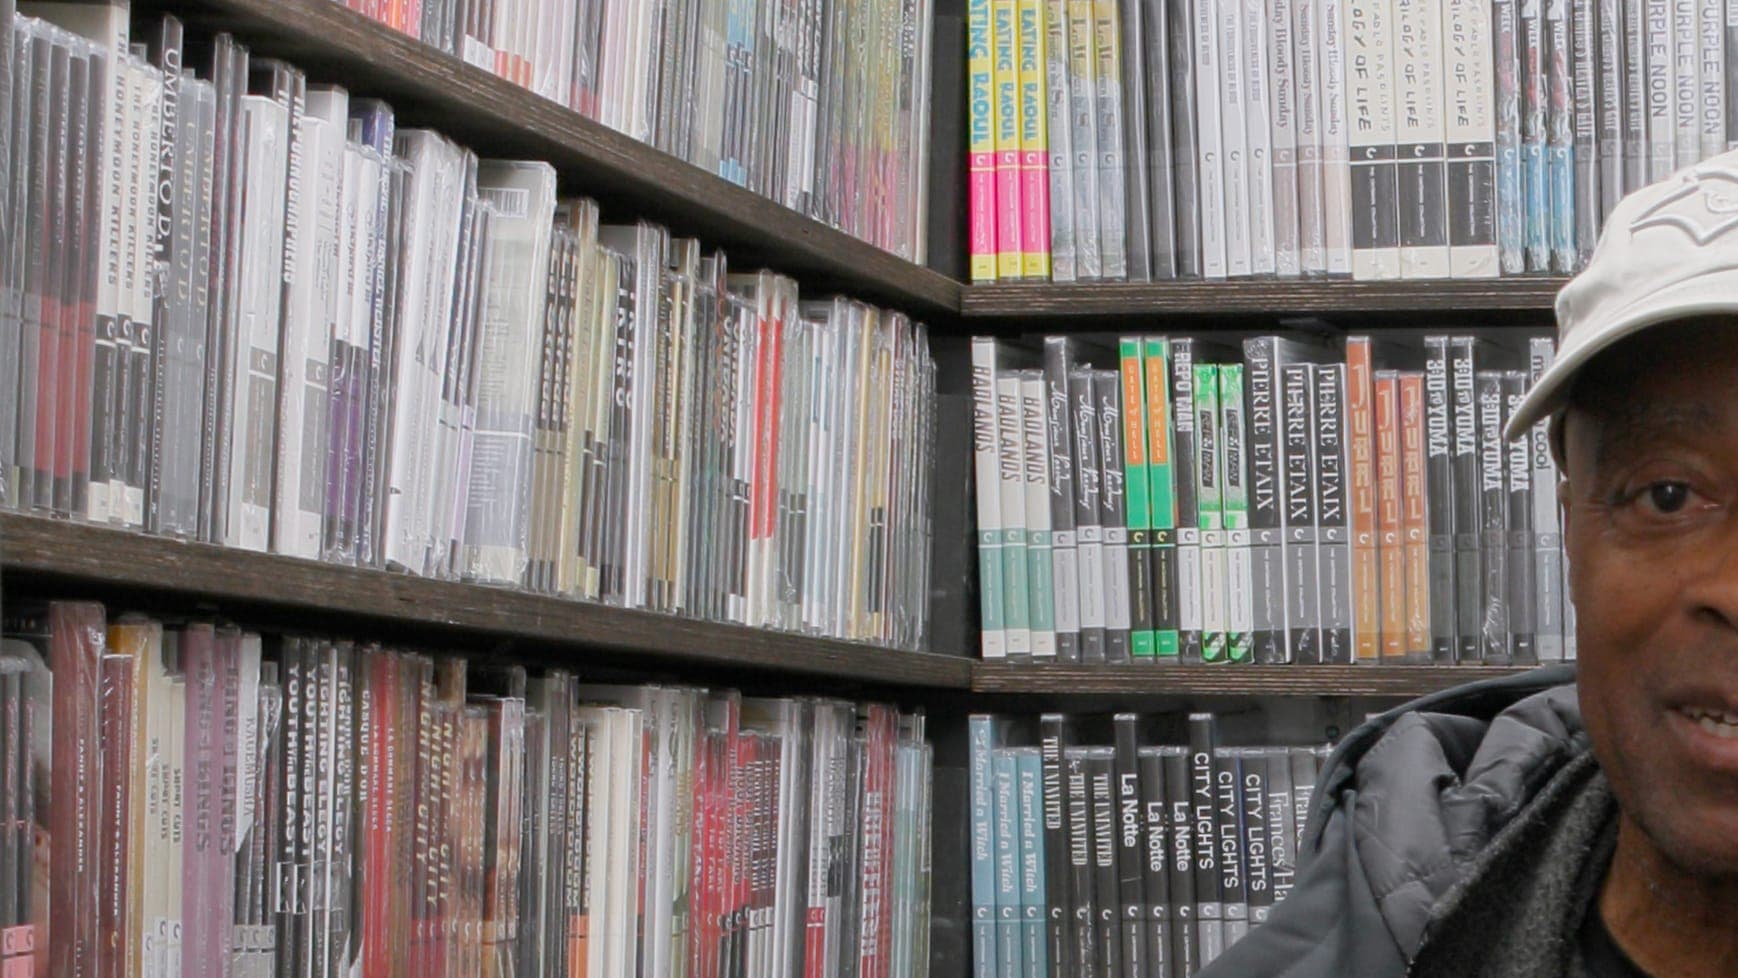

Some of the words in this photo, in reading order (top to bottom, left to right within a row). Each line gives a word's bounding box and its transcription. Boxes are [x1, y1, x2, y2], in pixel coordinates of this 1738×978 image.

[116, 31, 126, 65] THE
[996, 9, 1012, 71] EATING
[1022, 9, 1037, 71] EATING
[1274, 28, 1292, 75] Bloody
[1355, 55, 1368, 79] OF
[1404, 64, 1417, 83] OF
[1455, 63, 1466, 82] OF
[1651, 65, 1667, 118] NOON
[1678, 75, 1695, 128] NOON
[160, 49, 178, 204] UMBERTO
[972, 73, 989, 144] RAOUL
[1001, 83, 1015, 141] RAOUL
[1023, 83, 1038, 141] RAOUL
[1277, 79, 1295, 129] Sunday
[1356, 88, 1372, 132] LIFE
[1406, 91, 1419, 128] LIFE
[1456, 90, 1469, 127] LIFE
[1704, 82, 1721, 135] NOON
[111, 75, 125, 196] HONEYMOON
[108, 206, 121, 286] KILLERS
[1175, 351, 1191, 391] REPO
[1253, 358, 1273, 434] PIERRE
[973, 365, 995, 454] BADLANDS
[1101, 396, 1116, 463] Monsieur
[1176, 396, 1193, 432] MAN
[1286, 368, 1305, 446] PIERRE
[1318, 369, 1337, 446] PIERRE
[1427, 404, 1448, 457] YUMA
[1456, 403, 1475, 456] YUMA
[998, 395, 1020, 482] BADLANDS
[1023, 397, 1045, 484] BADLANDS
[1483, 438, 1502, 491] YUMA
[1535, 431, 1551, 470] cool
[1255, 443, 1275, 510] ETAIX
[1289, 455, 1307, 519] ETAIX
[1320, 455, 1340, 519] ETAIX
[287, 665, 300, 749] YOUTH
[319, 663, 329, 773] FIGHTING
[360, 690, 370, 756] CASQUE
[243, 717, 255, 817] KAGEMUSHA
[441, 723, 452, 800] NIGHT
[1043, 736, 1059, 762] THE
[1193, 752, 1209, 797] CITY
[1022, 781, 1035, 838] Married
[1044, 765, 1061, 829] UNINVITED
[1093, 774, 1108, 799] THE
[1121, 774, 1136, 795] La
[1148, 801, 1162, 823] La
[1174, 801, 1188, 823] La
[1218, 771, 1234, 817] CITY
[1245, 774, 1262, 819] CITY
[285, 773, 297, 855] BEAST
[317, 780, 328, 854] ELEGY
[1094, 802, 1112, 866] UNINVITED
[1123, 800, 1138, 847] Notte
[1197, 805, 1214, 870] LIGHTS
[1269, 792, 1288, 867] Frances
[439, 843, 450, 904] CITY
[1024, 853, 1037, 892] Witch
[1149, 826, 1164, 871] Notte
[1175, 826, 1191, 871] Notte
[1221, 824, 1238, 888] LIGHTS
[1249, 827, 1265, 891] LIGHTS
